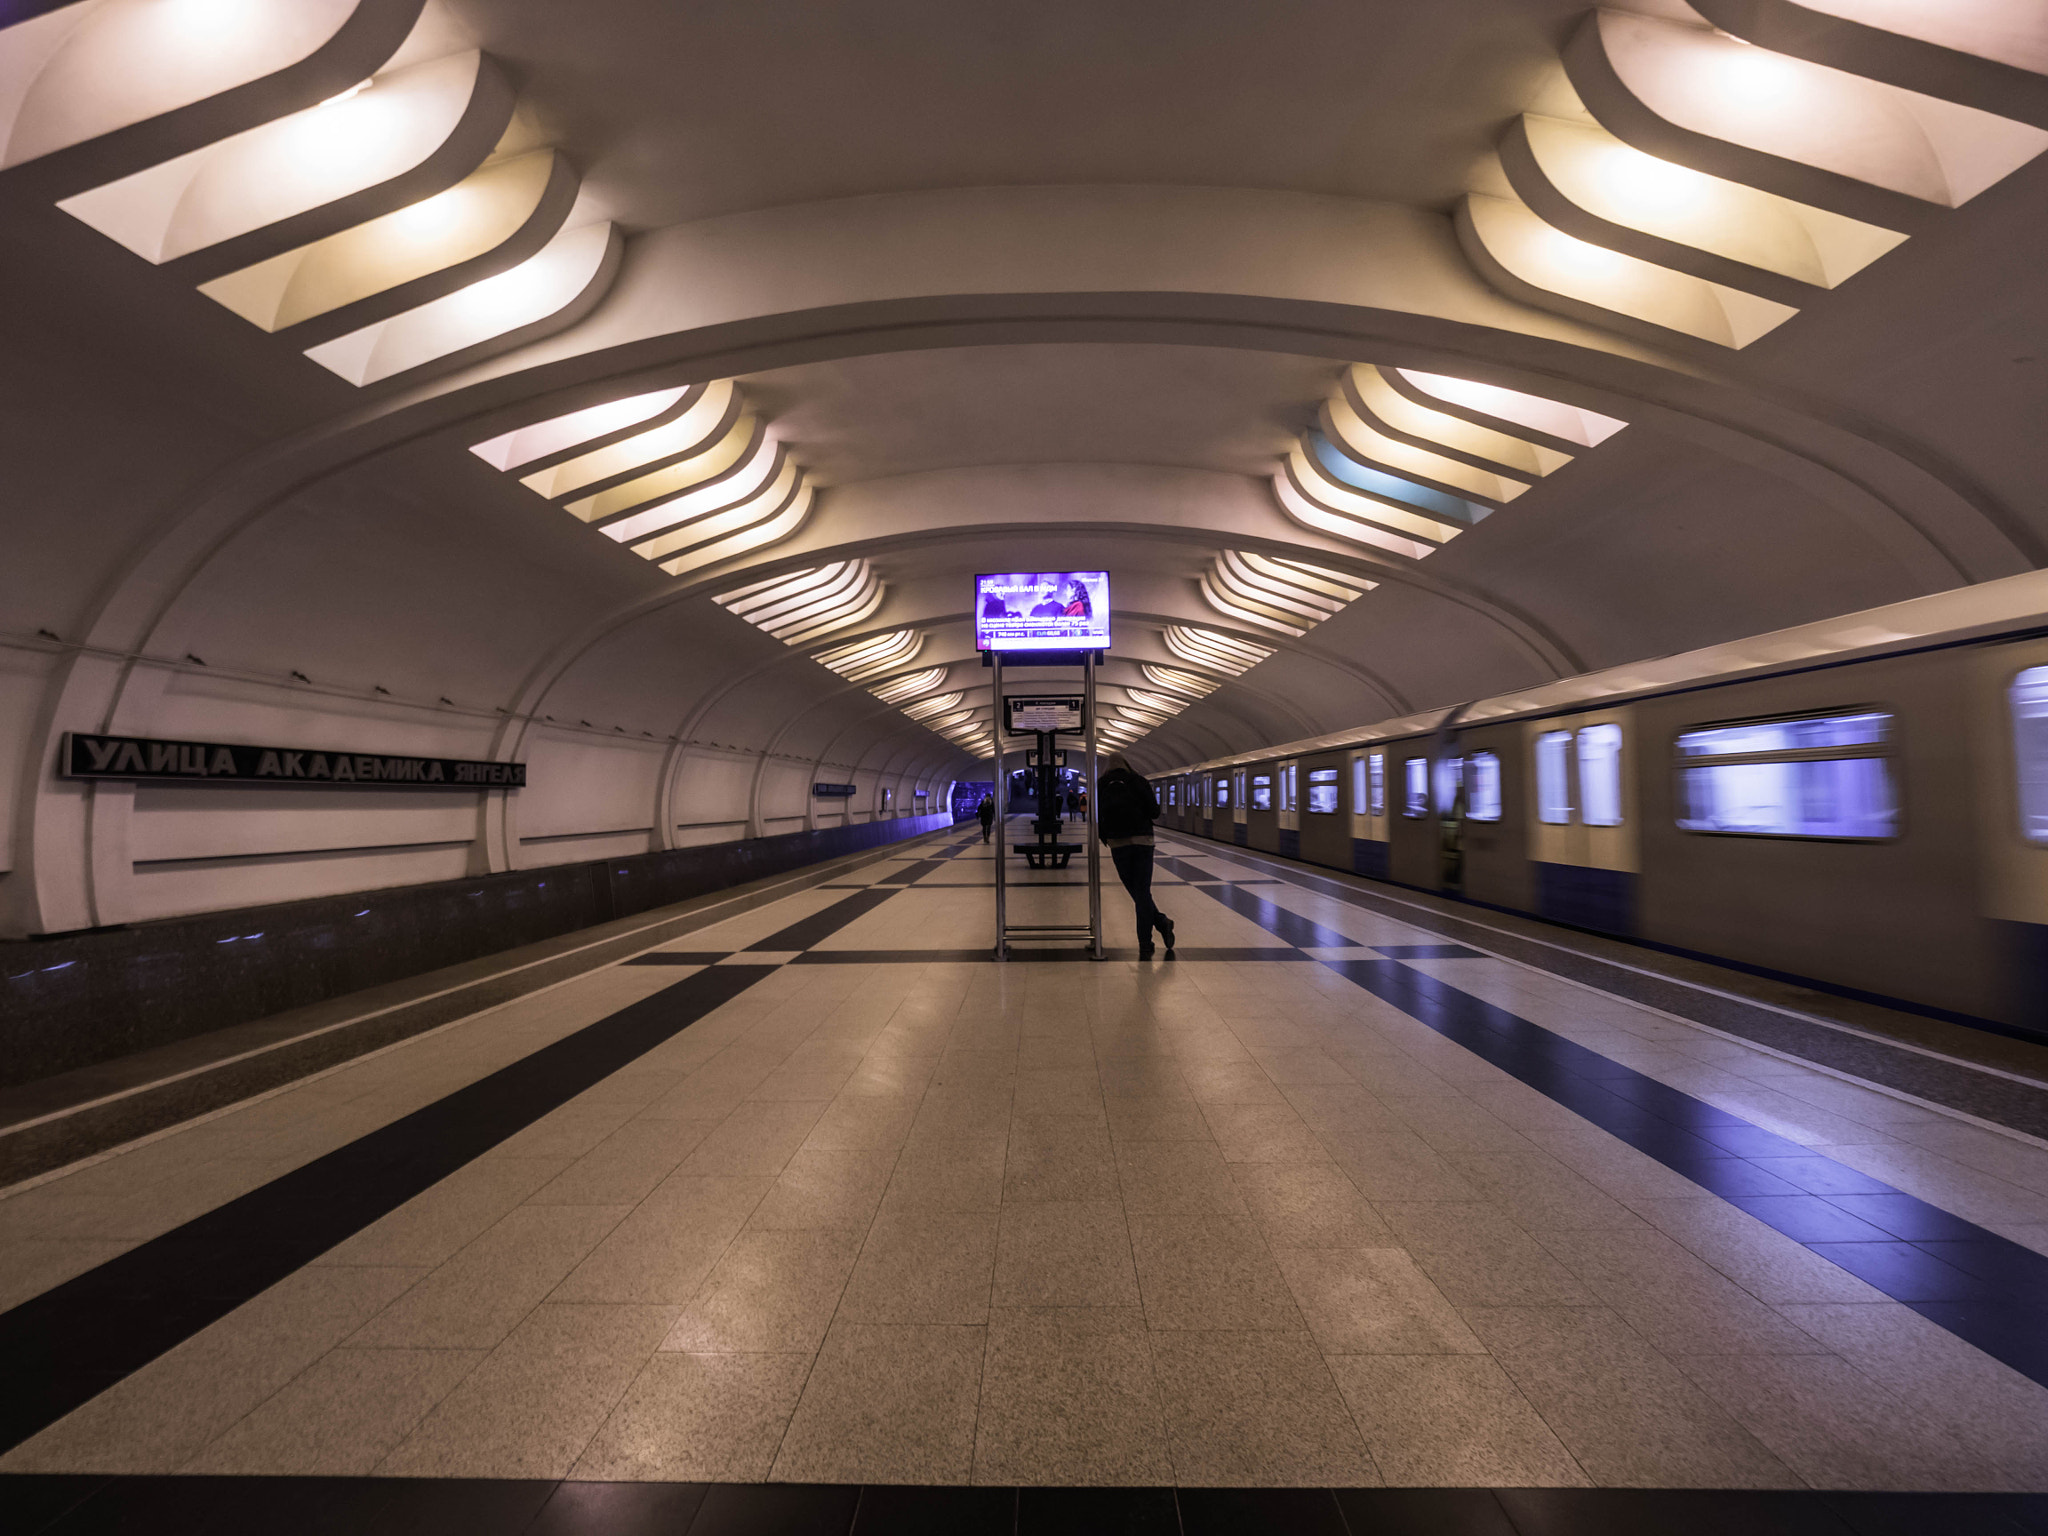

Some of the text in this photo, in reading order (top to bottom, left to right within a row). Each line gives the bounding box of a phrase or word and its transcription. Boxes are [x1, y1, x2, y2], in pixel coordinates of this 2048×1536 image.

[83, 739, 525, 784] УЛИЦА АКАДЕМИКА ЯНГЕЛЯ
